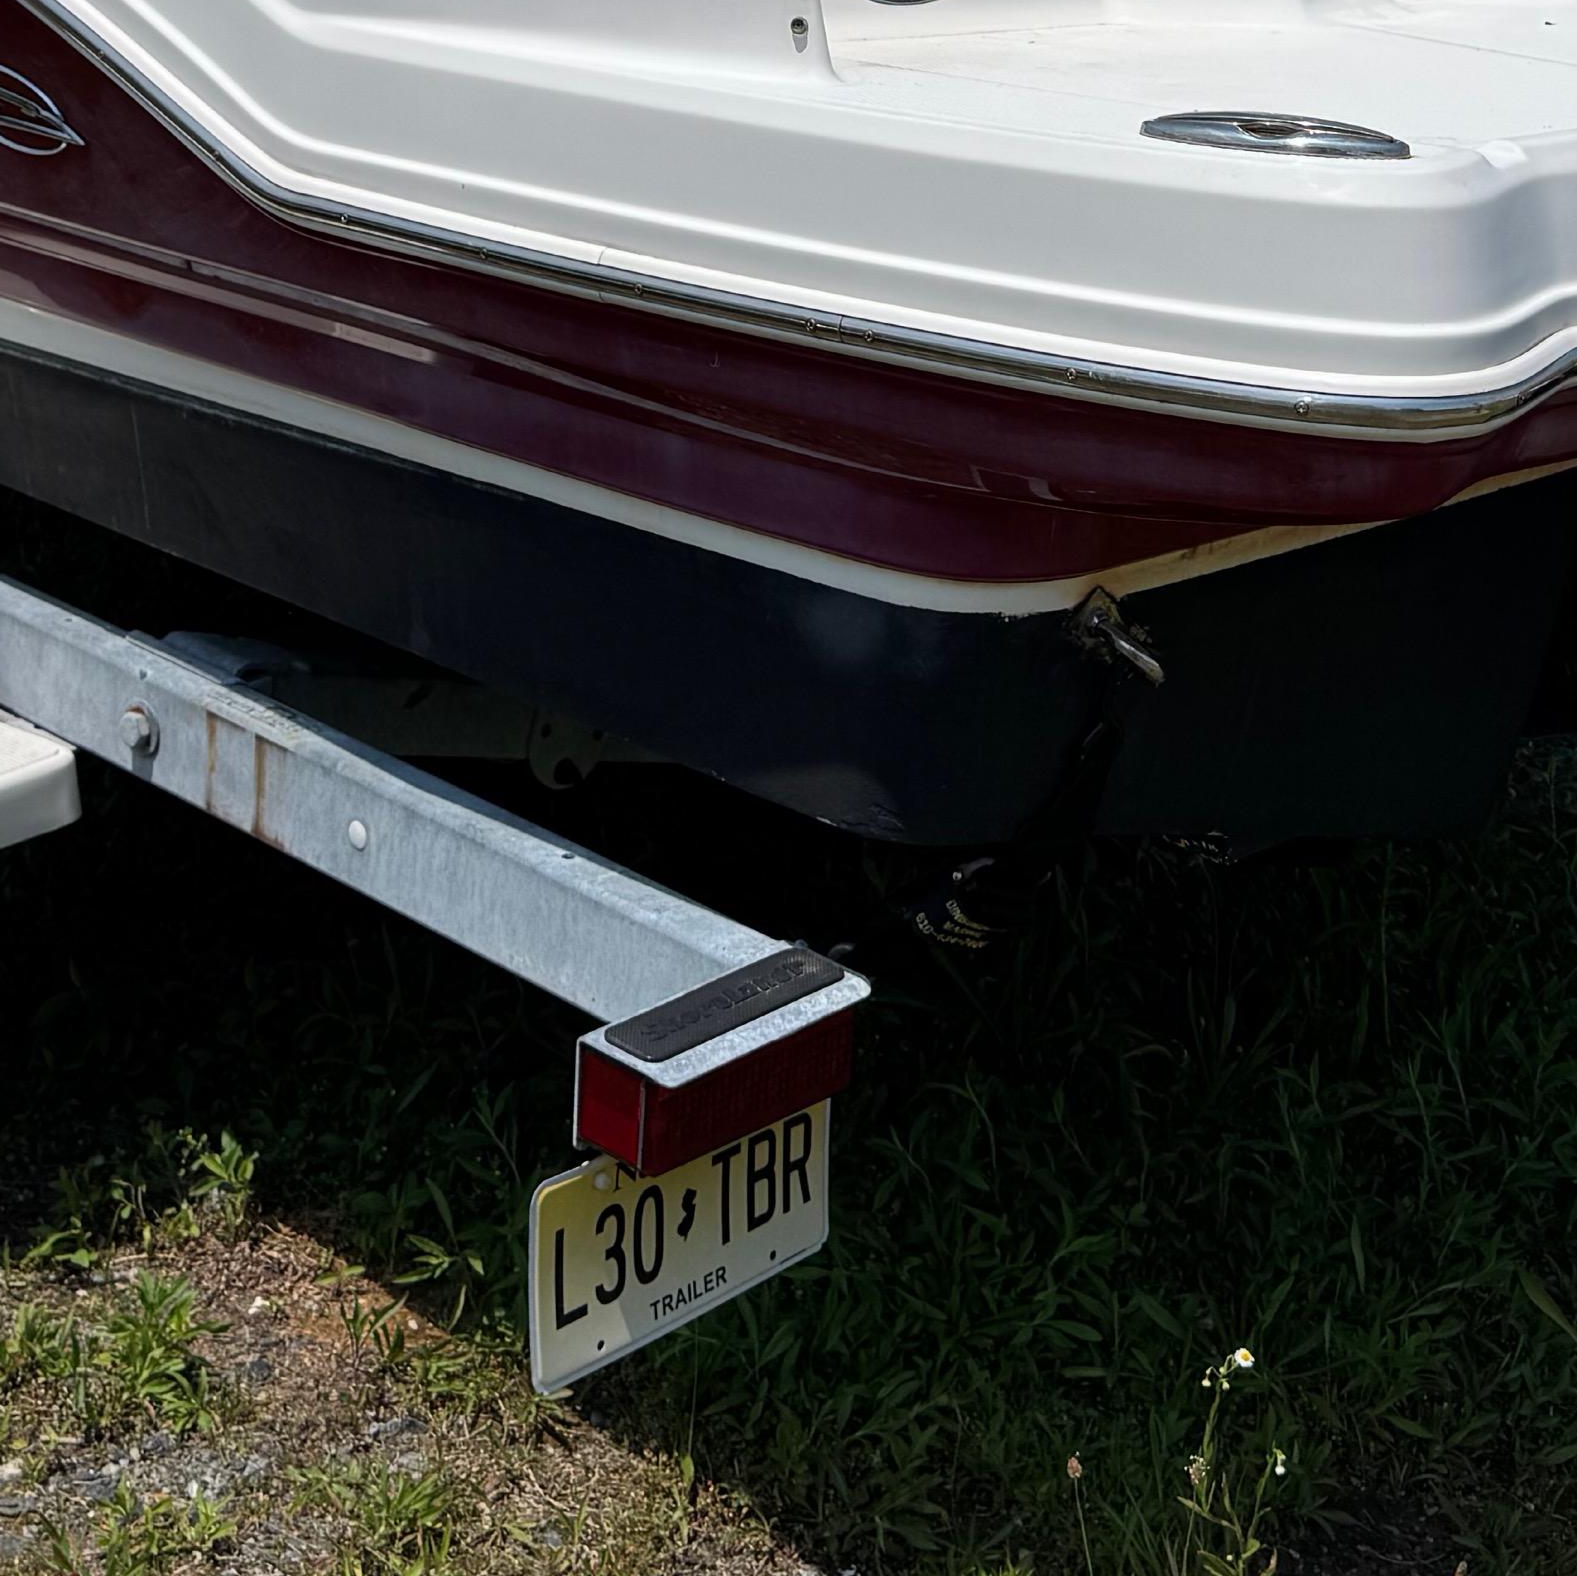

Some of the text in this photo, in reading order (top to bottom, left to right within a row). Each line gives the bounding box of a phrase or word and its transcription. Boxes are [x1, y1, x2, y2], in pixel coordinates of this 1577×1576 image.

[554, 1111, 813, 1331] L30 TBR
[649, 1265, 728, 1321] TRAILER
